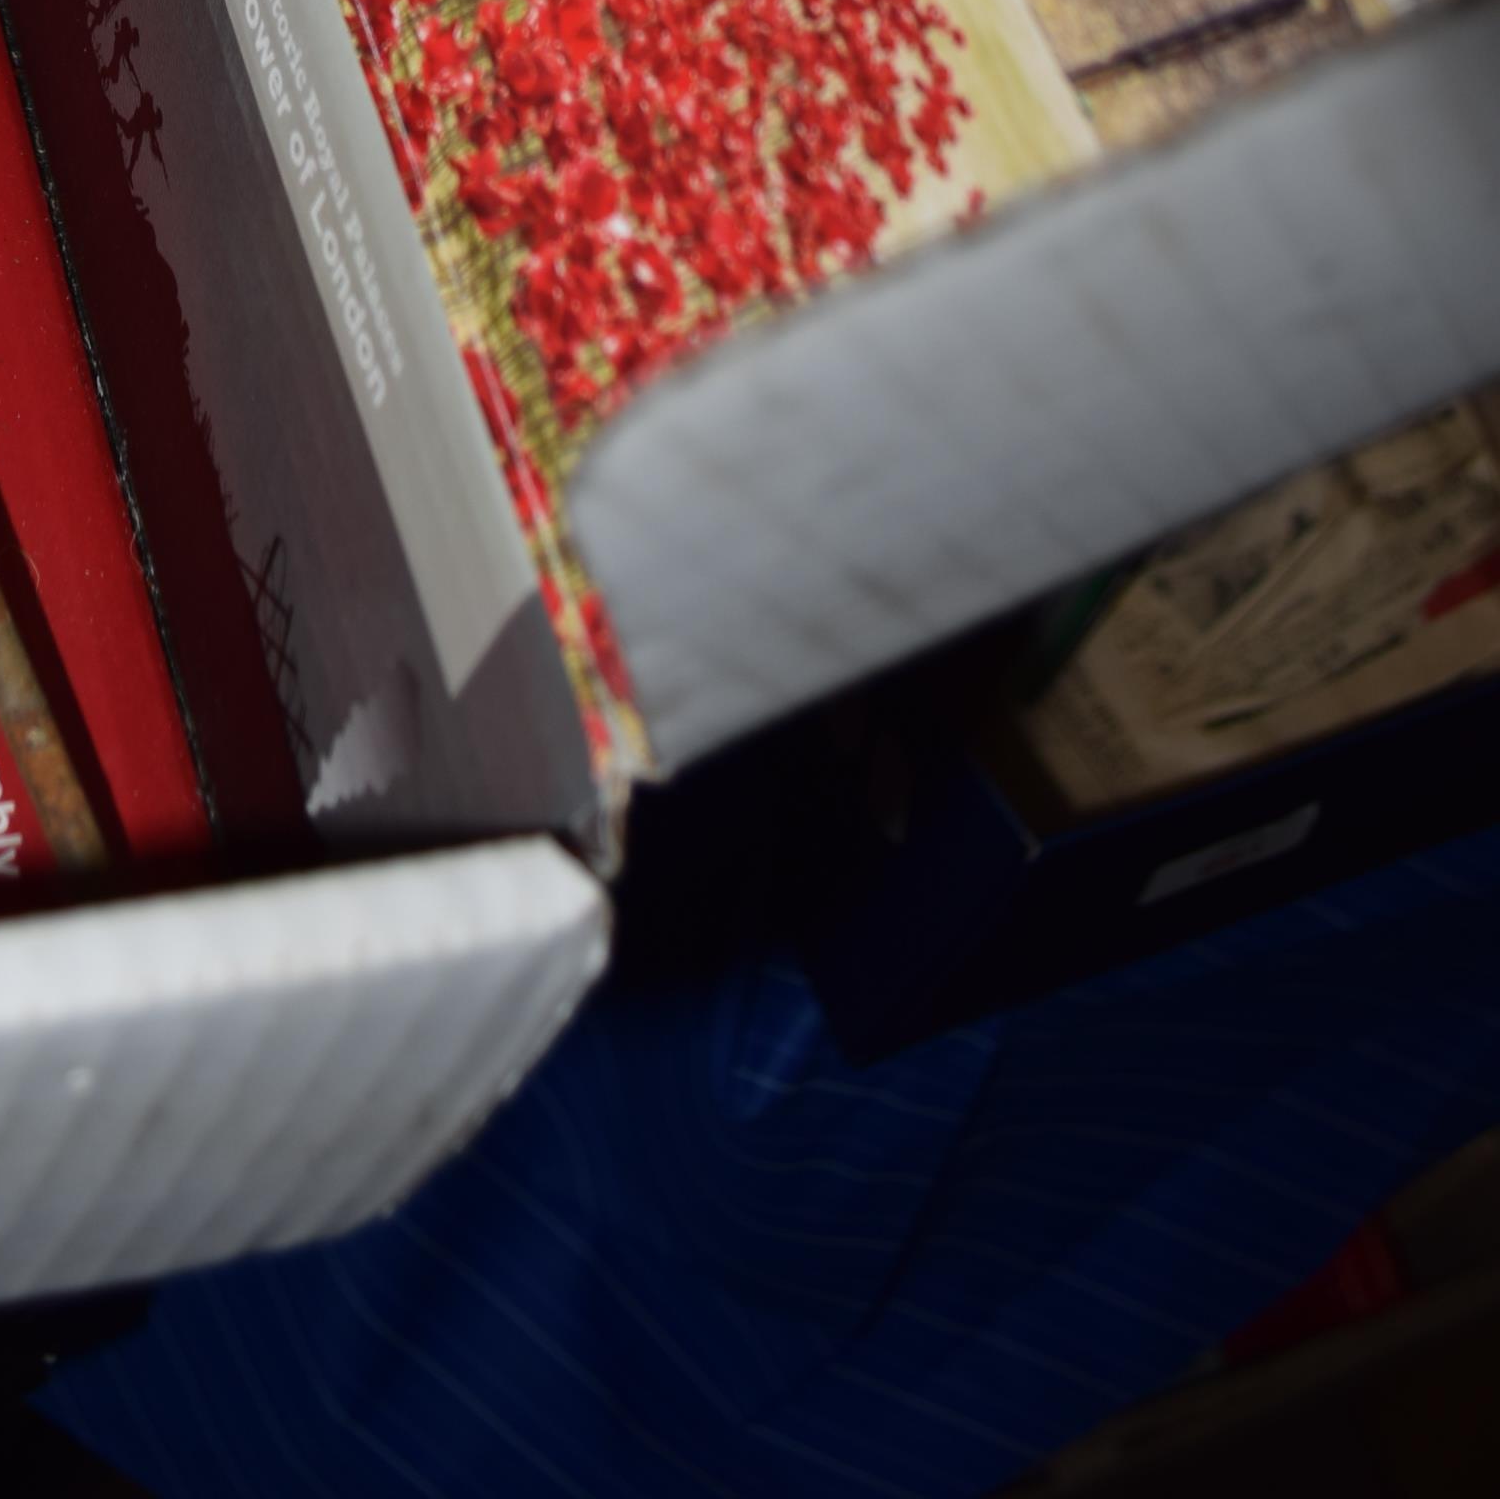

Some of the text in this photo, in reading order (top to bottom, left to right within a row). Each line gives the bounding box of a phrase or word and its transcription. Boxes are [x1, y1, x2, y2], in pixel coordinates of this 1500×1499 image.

[303, 87, 350, 207] Royal
[289, 131, 317, 187] of
[310, 191, 387, 409] London
